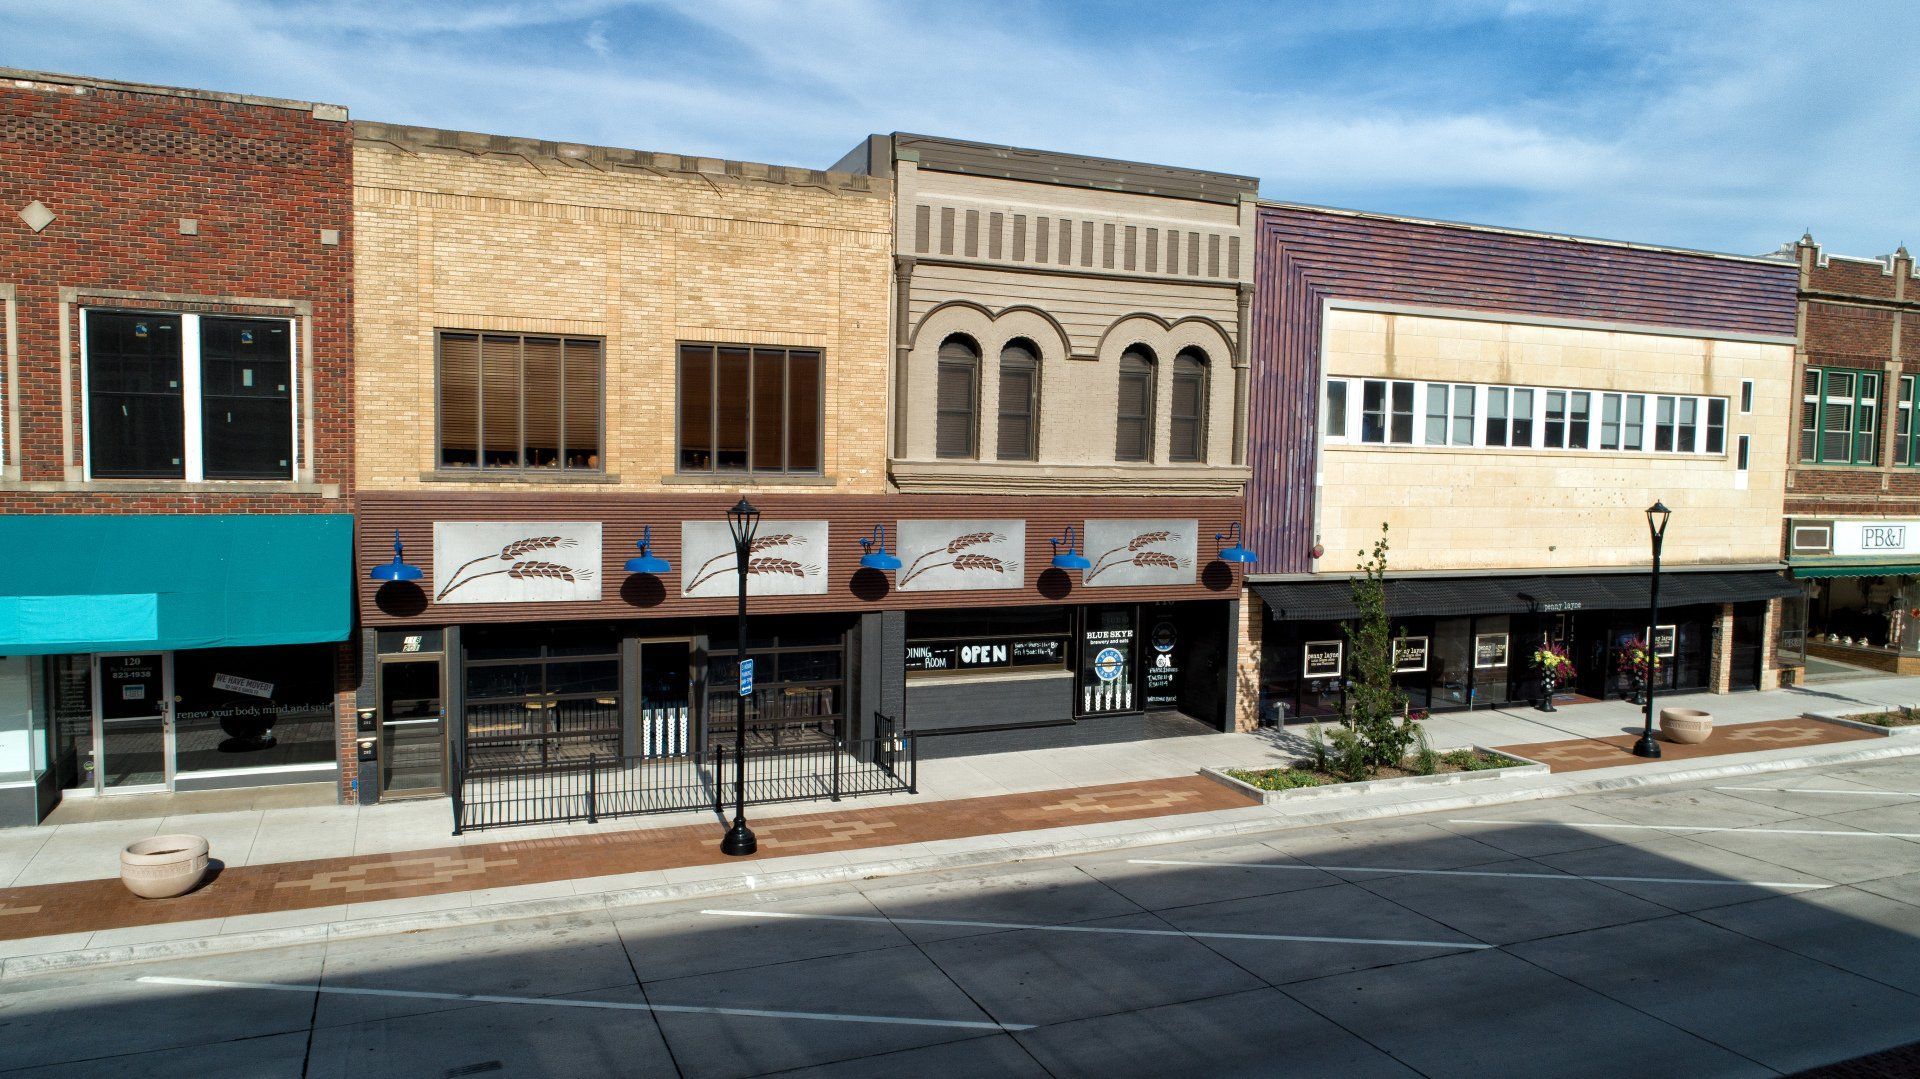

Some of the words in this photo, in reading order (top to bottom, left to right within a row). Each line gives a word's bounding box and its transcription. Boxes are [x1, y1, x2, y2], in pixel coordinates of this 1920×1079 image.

[1864, 528, 1903, 547] PB&J
[1544, 604, 1562, 612] penny
[1564, 601, 1582, 610] layne
[1110, 630, 1133, 638] SKYE
[961, 645, 1007, 663] OPEN
[1307, 653, 1324, 661] penny
[124, 657, 141, 666] 120
[925, 658, 946, 668] ROOM
[216, 673, 227, 683] WE
[227, 676, 245, 687] HAVE
[245, 679, 272, 692] MOVED!
[176, 710, 209, 719] renew
[211, 709, 233, 720] your
[289, 702, 309, 713] and
